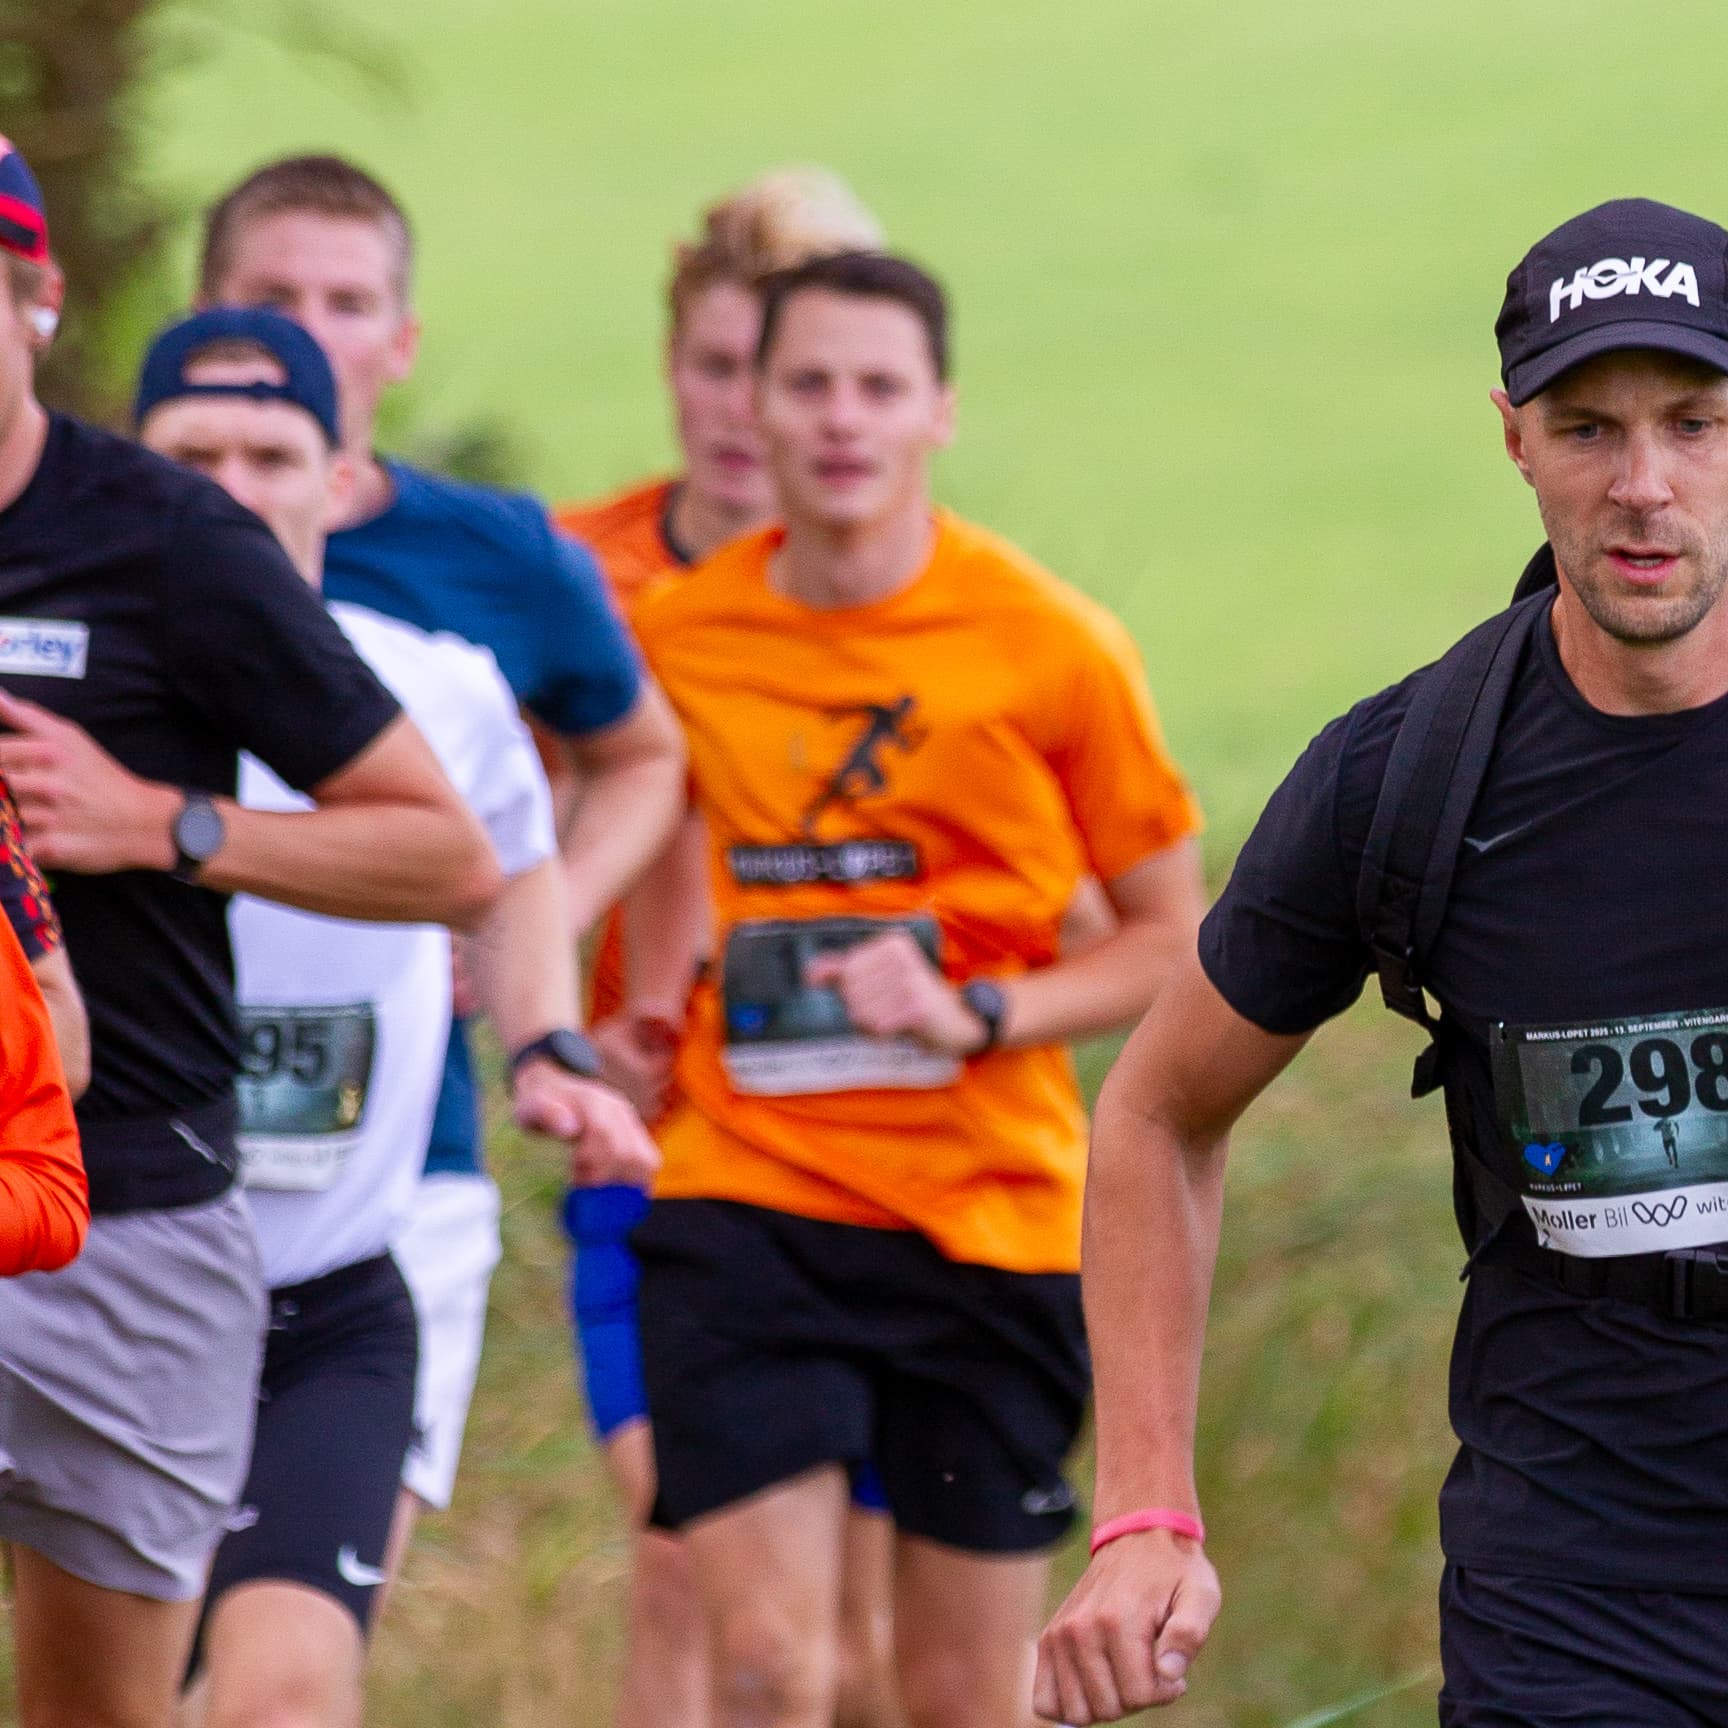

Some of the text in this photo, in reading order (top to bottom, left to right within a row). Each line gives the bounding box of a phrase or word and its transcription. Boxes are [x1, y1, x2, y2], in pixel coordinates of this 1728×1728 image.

[1550, 256, 1700, 323] HOKA
[1628, 1019, 1679, 1033] SEPTEMBER
[1604, 1205, 1629, 1229] Bil
